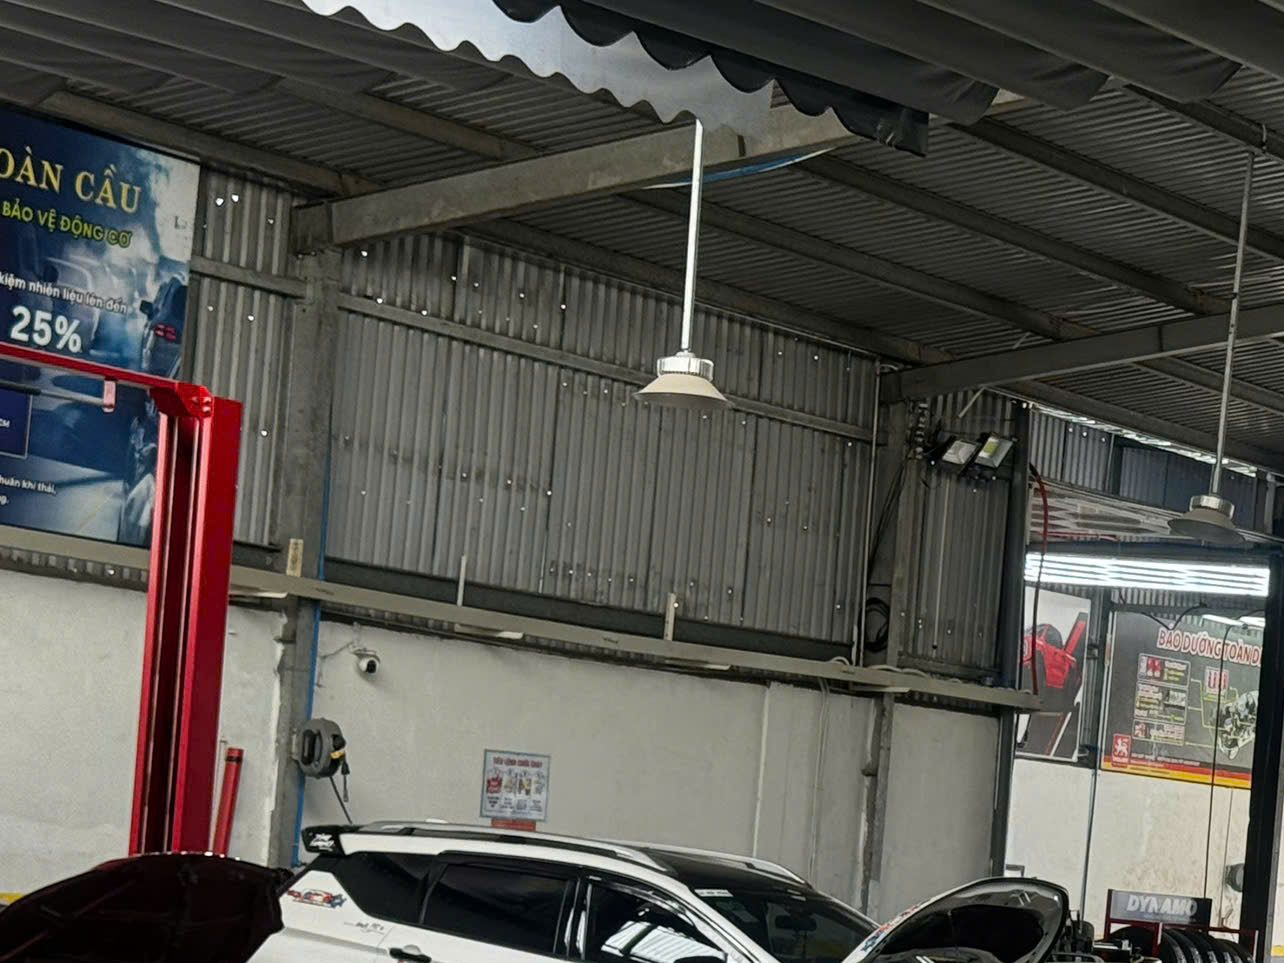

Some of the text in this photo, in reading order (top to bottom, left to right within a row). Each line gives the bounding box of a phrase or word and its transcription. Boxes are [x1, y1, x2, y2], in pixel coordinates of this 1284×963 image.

[75, 164, 142, 213] CẦU
[2, 198, 34, 222] BẢO
[37, 208, 56, 232] VỆ
[60, 215, 104, 241] ĐỘNG
[10, 305, 82, 353] 25%
